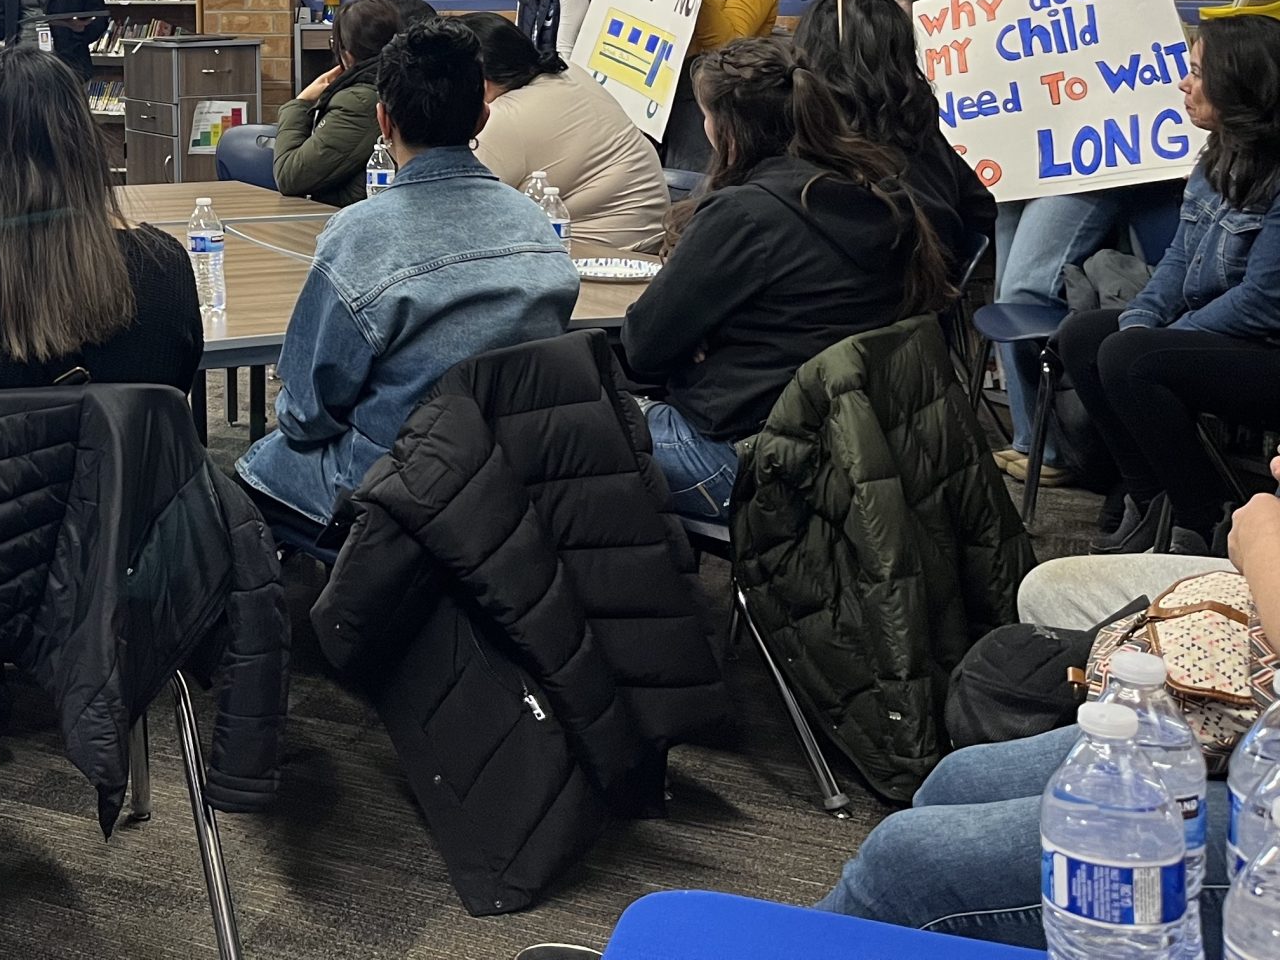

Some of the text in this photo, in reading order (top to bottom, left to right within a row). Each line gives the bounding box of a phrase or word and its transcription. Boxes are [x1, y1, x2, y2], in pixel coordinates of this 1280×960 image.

[924, 4, 1100, 81] MY Child
[1037, 108, 1190, 179] LONG
